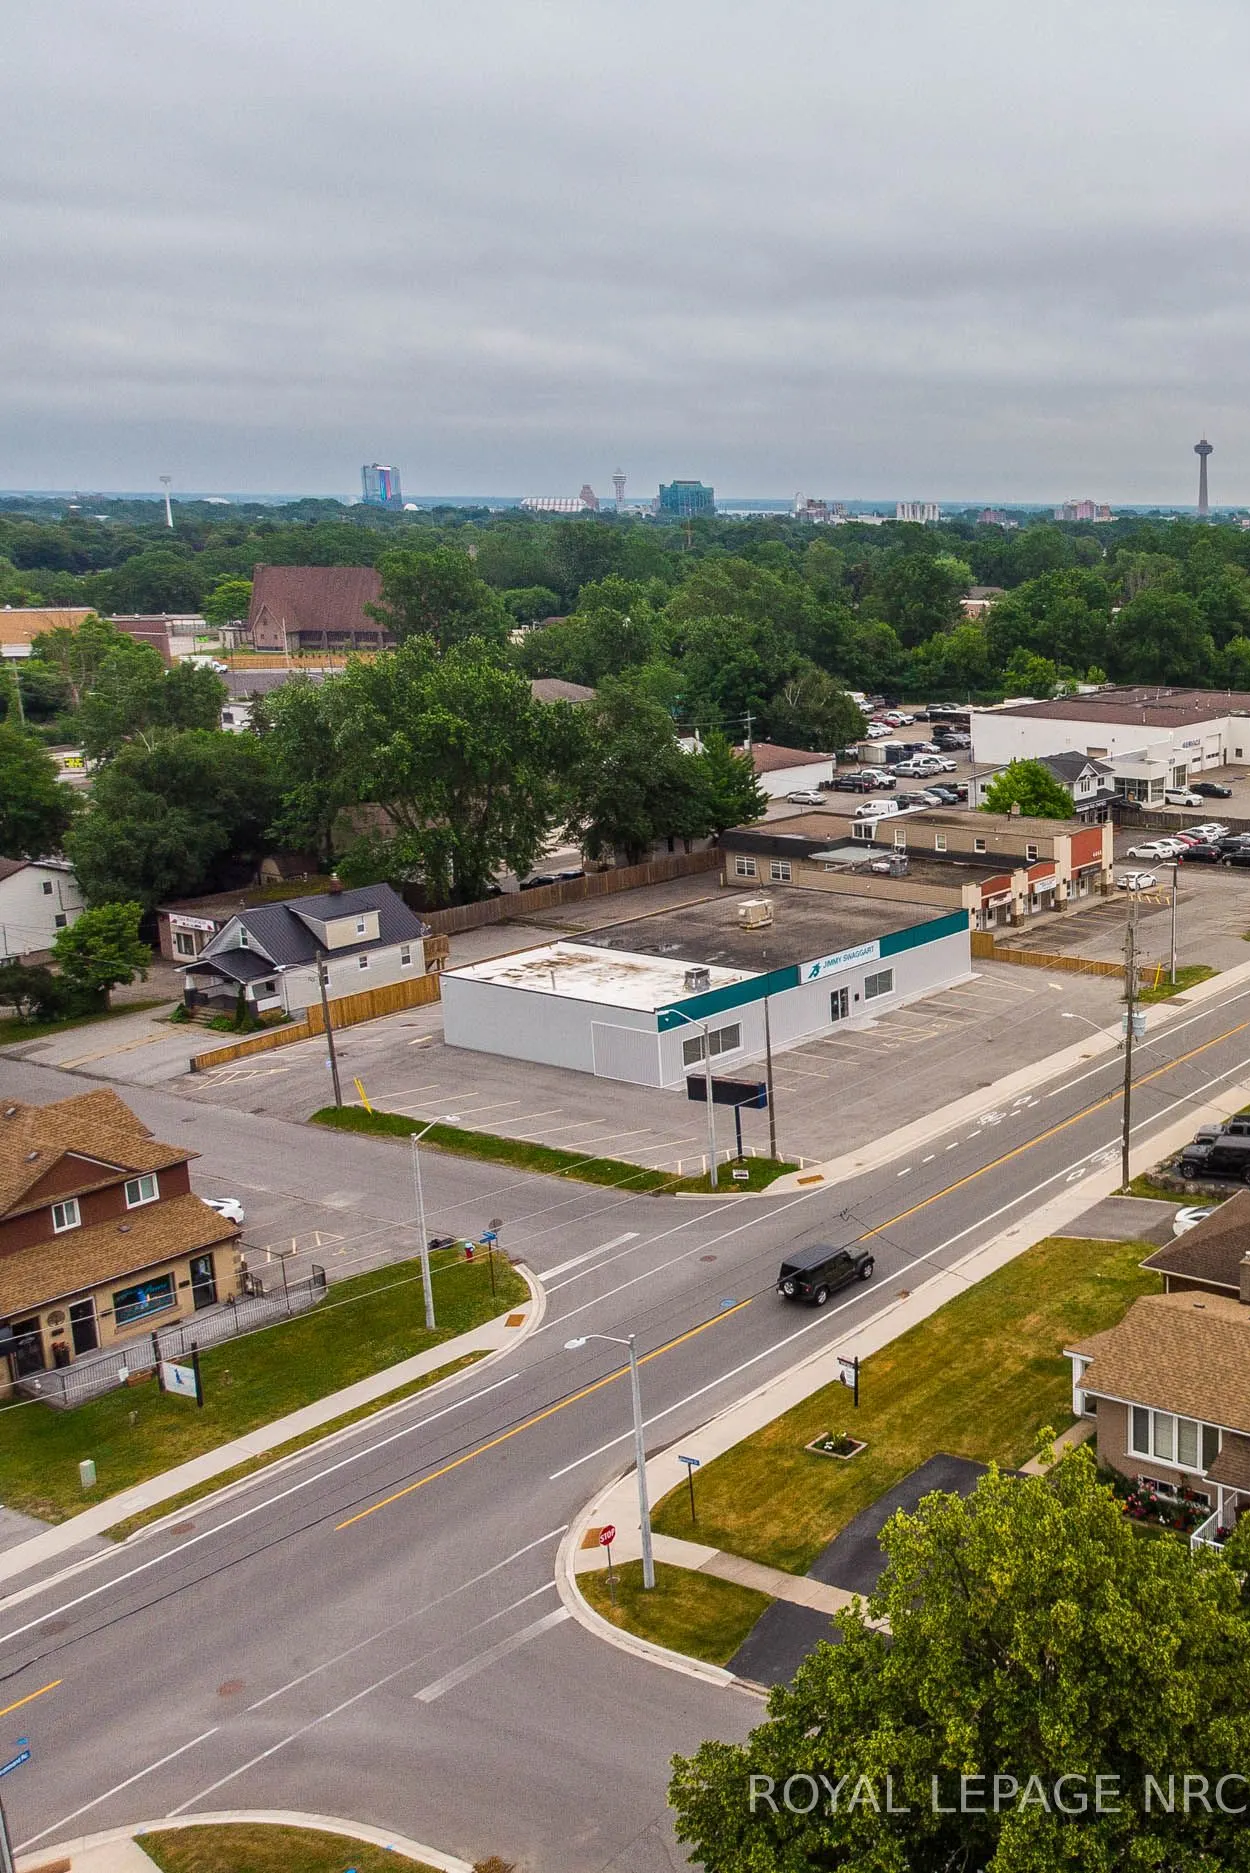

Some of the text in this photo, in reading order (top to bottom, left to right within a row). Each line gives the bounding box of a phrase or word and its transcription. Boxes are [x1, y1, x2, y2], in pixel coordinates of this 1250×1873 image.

[823, 945, 875, 969] JIMMY SWAGGART
[599, 1527, 615, 1543] STOP
